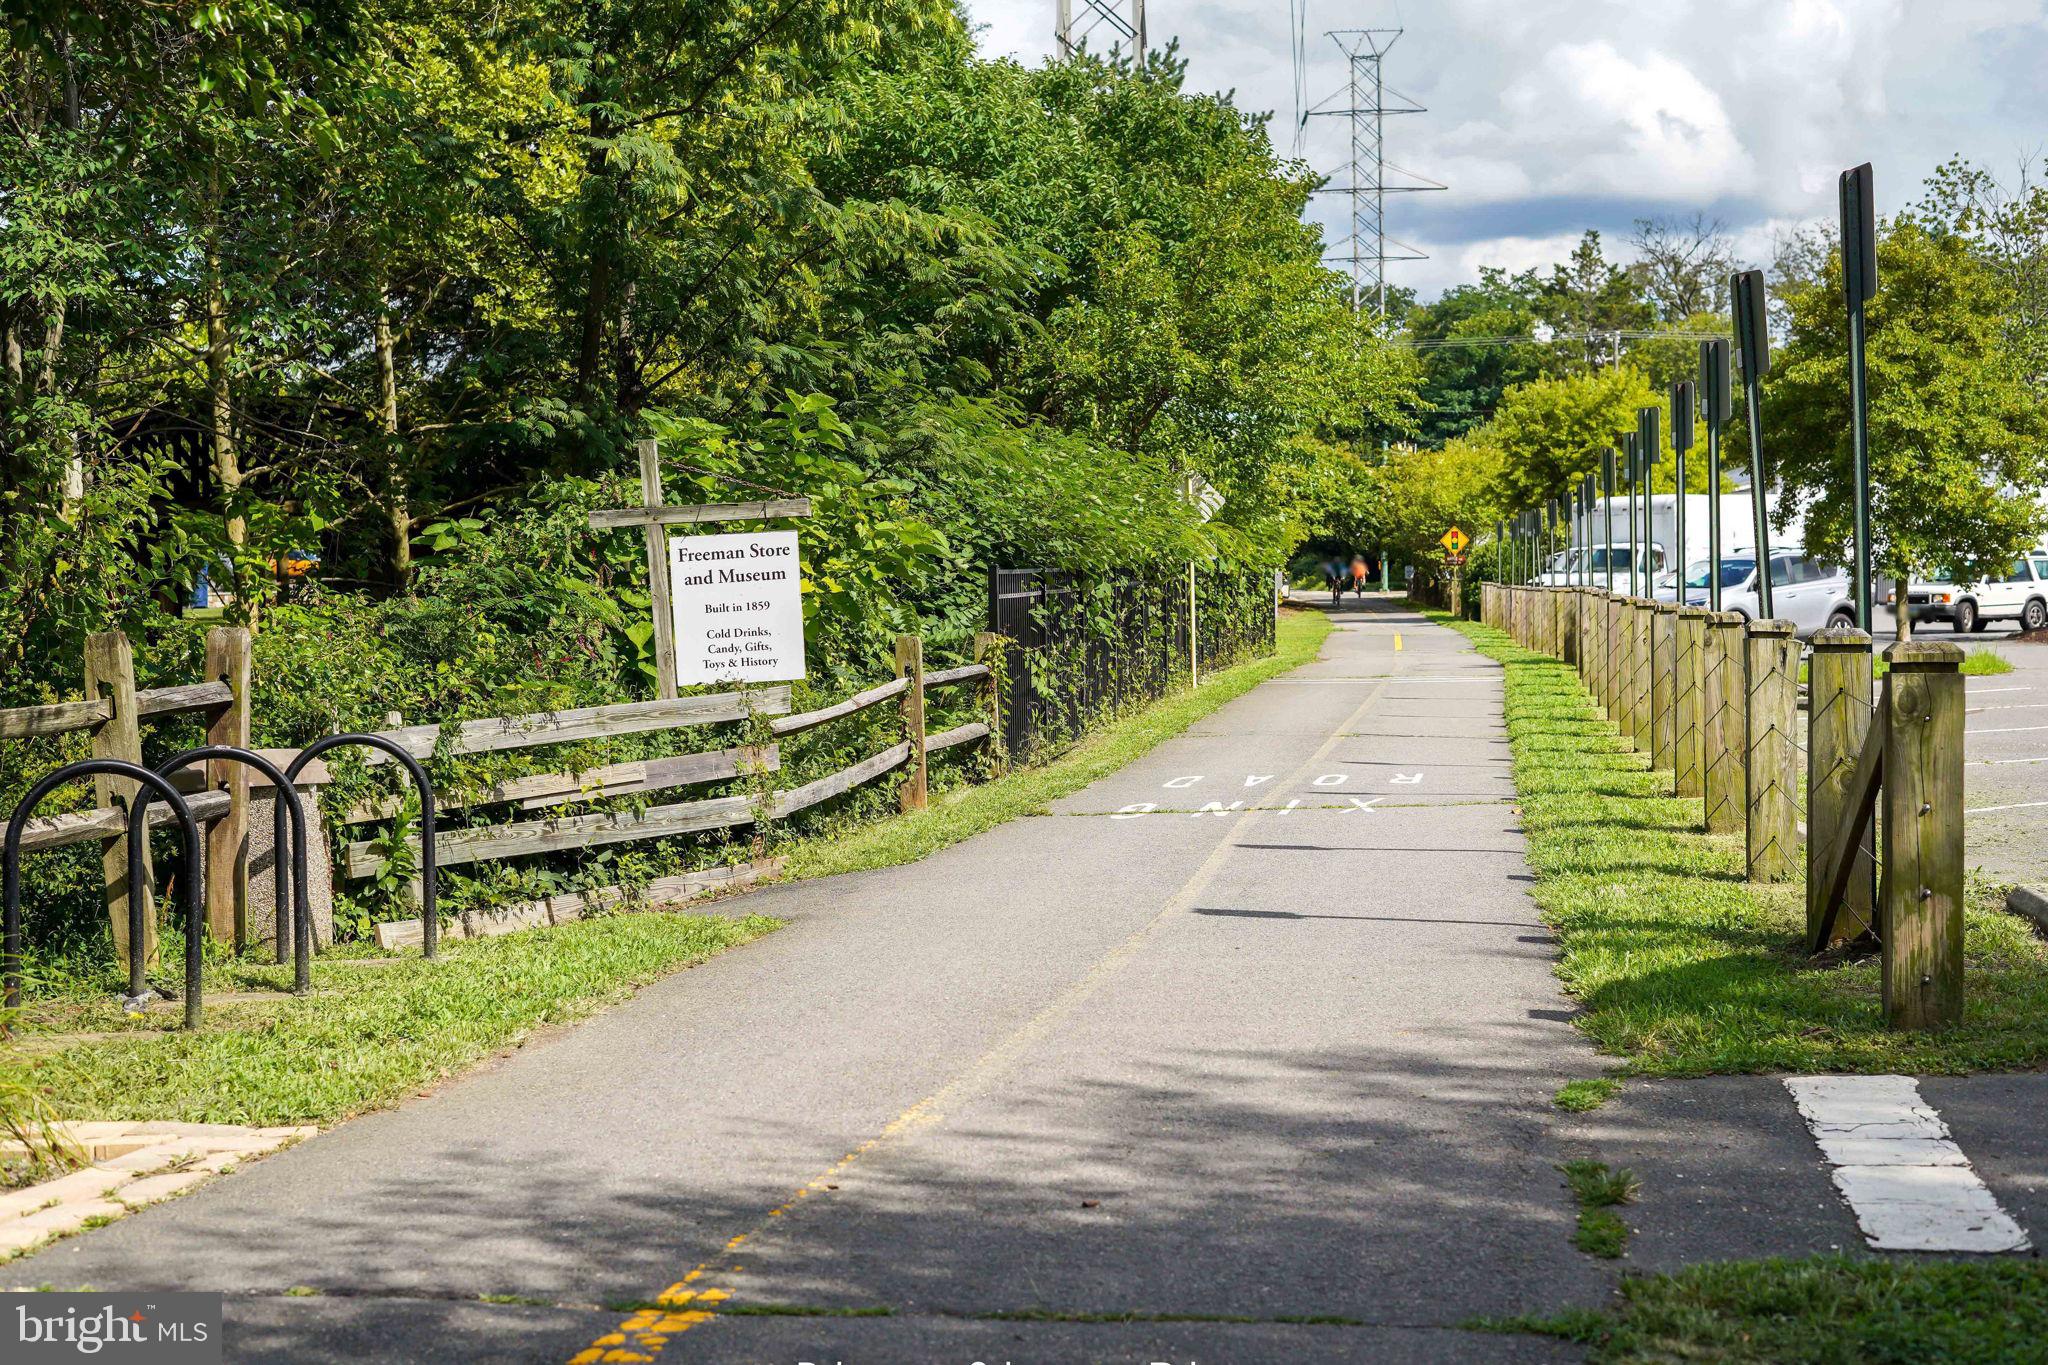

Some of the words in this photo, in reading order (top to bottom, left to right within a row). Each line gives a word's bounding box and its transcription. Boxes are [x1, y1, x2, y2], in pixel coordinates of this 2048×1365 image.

[678, 547, 745, 563] Freeman
[749, 543, 791, 558] Store
[684, 569, 714, 586] and
[718, 568, 787, 584] Museum
[705, 602, 730, 614] Built
[732, 603, 743, 612] in
[746, 600, 771, 611] 1859
[706, 628, 731, 639] Cold
[734, 626, 772, 638] Drinks,
[707, 643, 742, 656] Candy,
[744, 640, 772, 652] Gifts,
[702, 659, 726, 671] Toys
[728, 658, 737, 668] &
[741, 657, 779, 668] History
[1162, 773, 1424, 788] ROAD
[1110, 797, 1386, 820] XING
